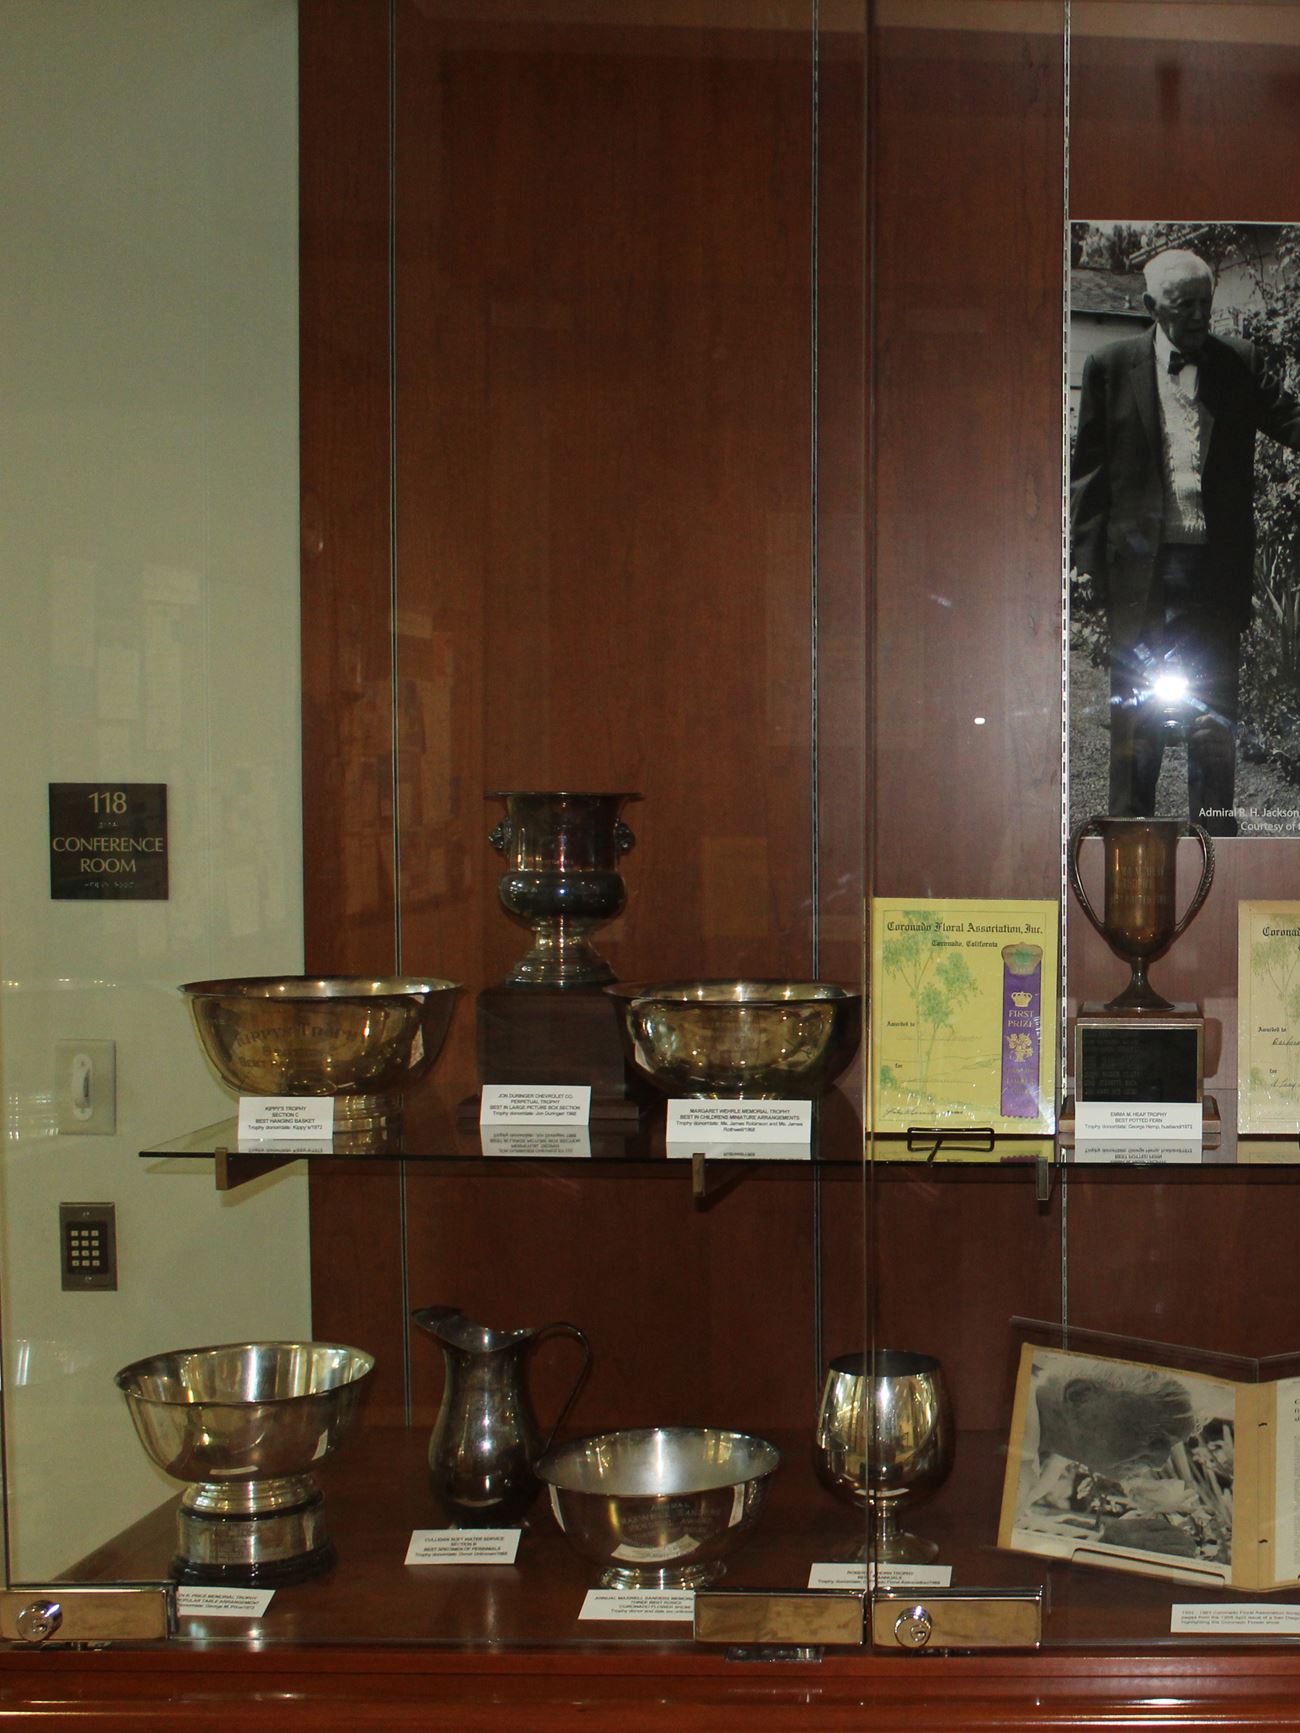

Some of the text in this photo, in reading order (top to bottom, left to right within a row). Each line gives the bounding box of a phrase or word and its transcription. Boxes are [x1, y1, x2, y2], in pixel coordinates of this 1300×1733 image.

[88, 792, 127, 814] 118
[1199, 808, 1236, 817] Admiral
[1250, 809, 1259, 817] H.
[1262, 808, 1299, 817] Jackson
[1241, 822, 1283, 831] Courtesy
[1286, 821, 1296, 831] of
[53, 837, 163, 852] CONFERENCE
[81, 858, 136, 872] ROOM
[887, 923, 931, 934] Coronado
[935, 923, 964, 933] Floral
[1009, 1010, 1033, 1018] FIRST
[1008, 1020, 1033, 1028] PRIZE
